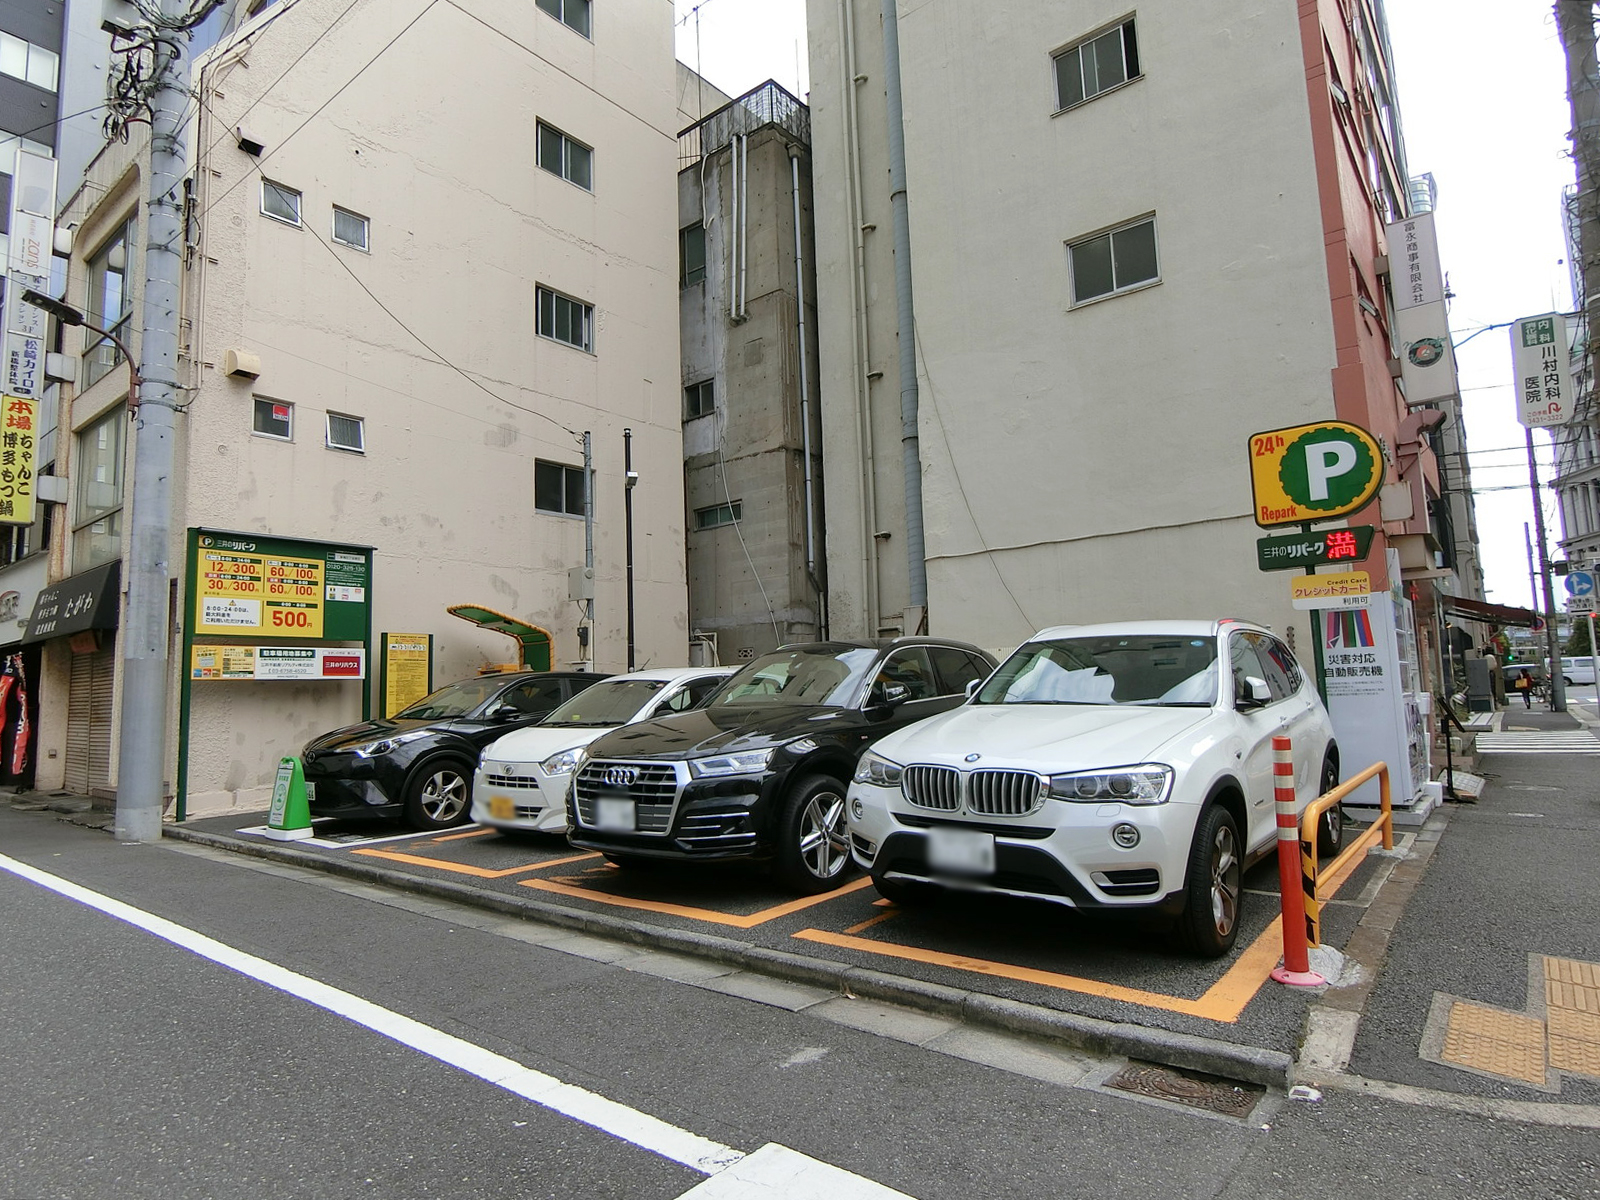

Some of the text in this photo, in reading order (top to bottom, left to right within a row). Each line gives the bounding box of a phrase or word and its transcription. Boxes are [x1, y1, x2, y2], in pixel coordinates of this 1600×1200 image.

[1404, 221, 1424, 303] 富永商事有限会社
[1538, 320, 1551, 343] 内科
[1542, 345, 1561, 400] 川村内科
[1525, 376, 1541, 404] 医院
[6, 400, 33, 431] 本場
[1528, 414, 1563, 424] 3431-3322
[0, 431, 18, 516] 博多もつ鍋
[17, 434, 33, 496] ちゃんこ
[1305, 440, 1357, 501] P
[1261, 505, 1297, 521] Repark
[217, 539, 256, 551] 三井のリパーク
[1263, 542, 1325, 558] 三井のリパーク
[1326, 531, 1356, 559] 満
[1295, 584, 1367, 597] クレジットカード
[1343, 596, 1368, 606] 利用可
[273, 610, 313, 628] 500円
[1328, 653, 1376, 665] 災害対応
[1325, 666, 1384, 678] 自動販売機
